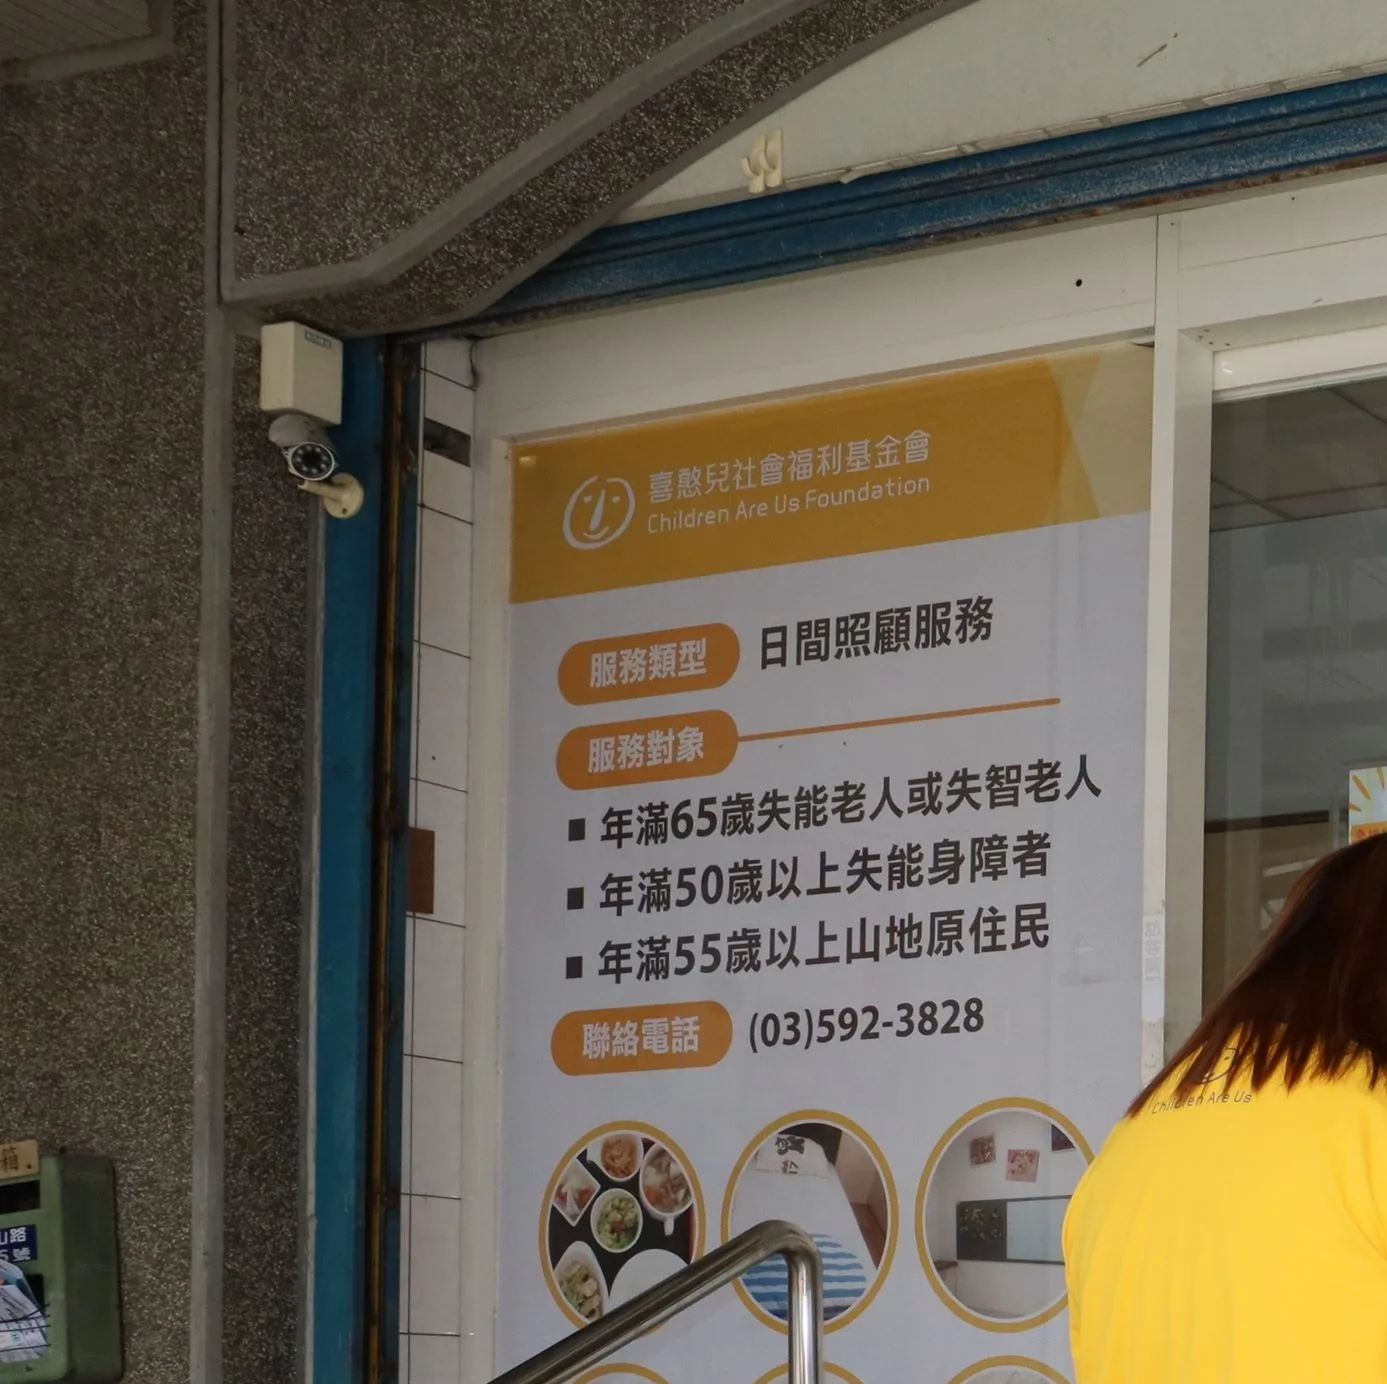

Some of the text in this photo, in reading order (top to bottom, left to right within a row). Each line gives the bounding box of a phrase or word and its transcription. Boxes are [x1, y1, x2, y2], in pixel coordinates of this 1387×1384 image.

[648, 429, 931, 504] 喜憨兒社會福利基金會
[648, 476, 930, 533] Children Are Us Foundation
[759, 596, 994, 669] 日間照顧服務
[590, 638, 708, 688] 服務類型
[588, 726, 704, 773] 服務對象
[600, 754, 1102, 849] 年滿65歲失能老人或失智老人
[600, 829, 1052, 917] 年滿50歲以上失能身障者
[599, 902, 1050, 984] 年滿55歲以上山地原住民
[583, 1016, 700, 1058] 聯絡電話
[748, 998, 985, 1052] (03)592-3828
[1208, 1091, 1230, 1104] Are
[1234, 1090, 1252, 1103] Us
